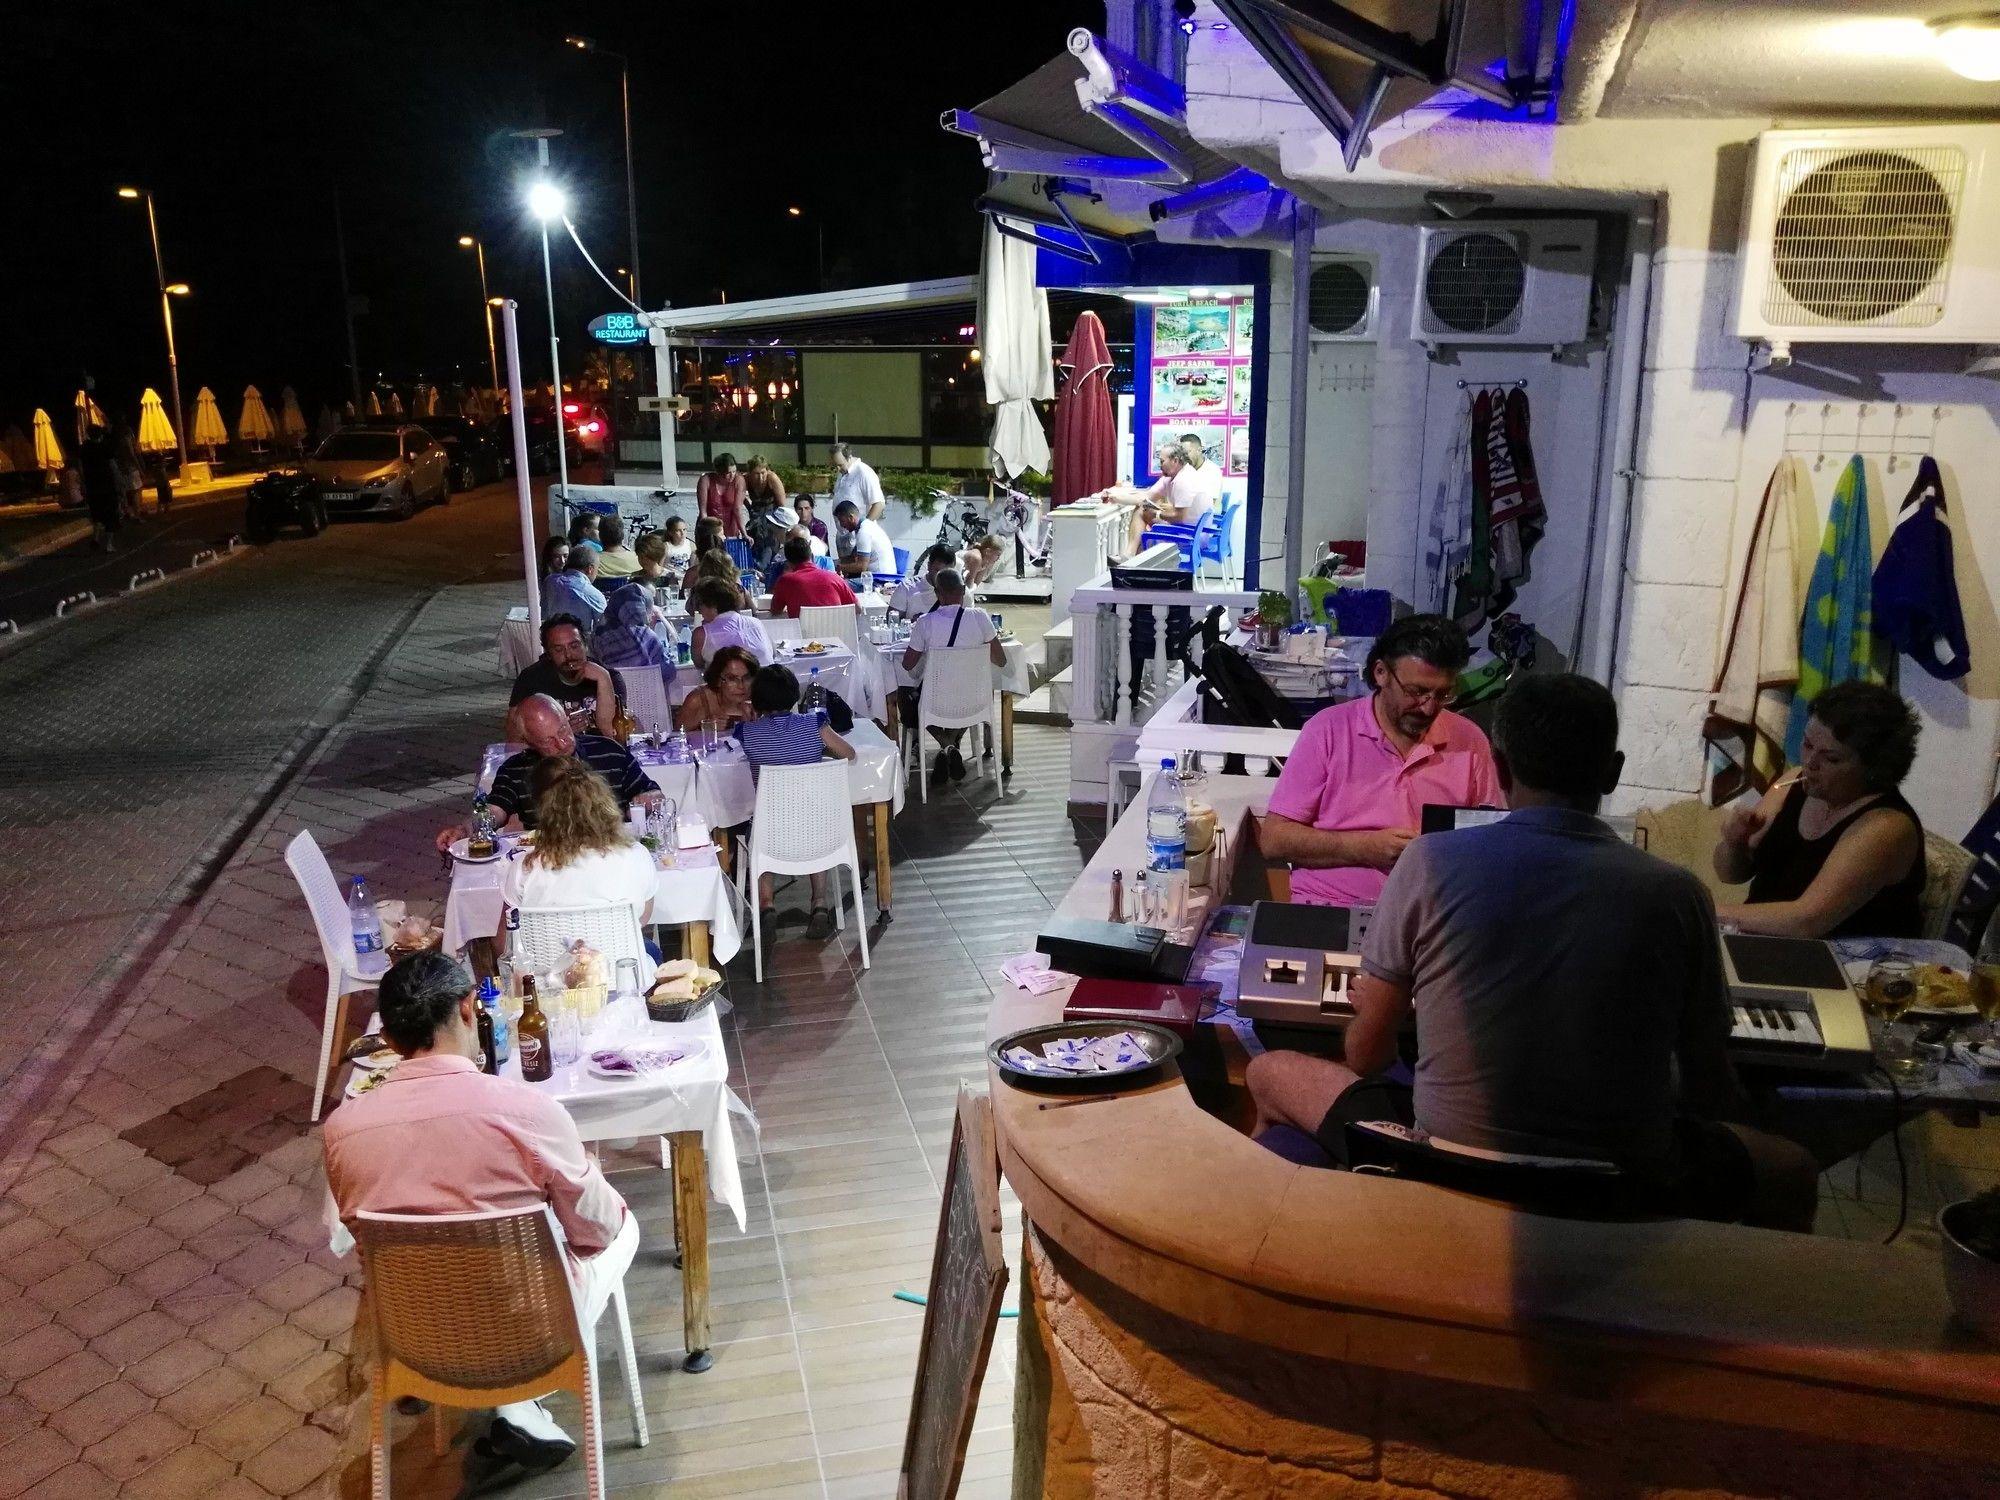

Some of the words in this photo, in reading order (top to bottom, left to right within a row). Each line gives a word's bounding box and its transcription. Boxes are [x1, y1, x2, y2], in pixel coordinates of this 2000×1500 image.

[1195, 299, 1218, 307] BEACH
[607, 315, 634, 329] B&B
[595, 329, 647, 338] RESTAURANT
